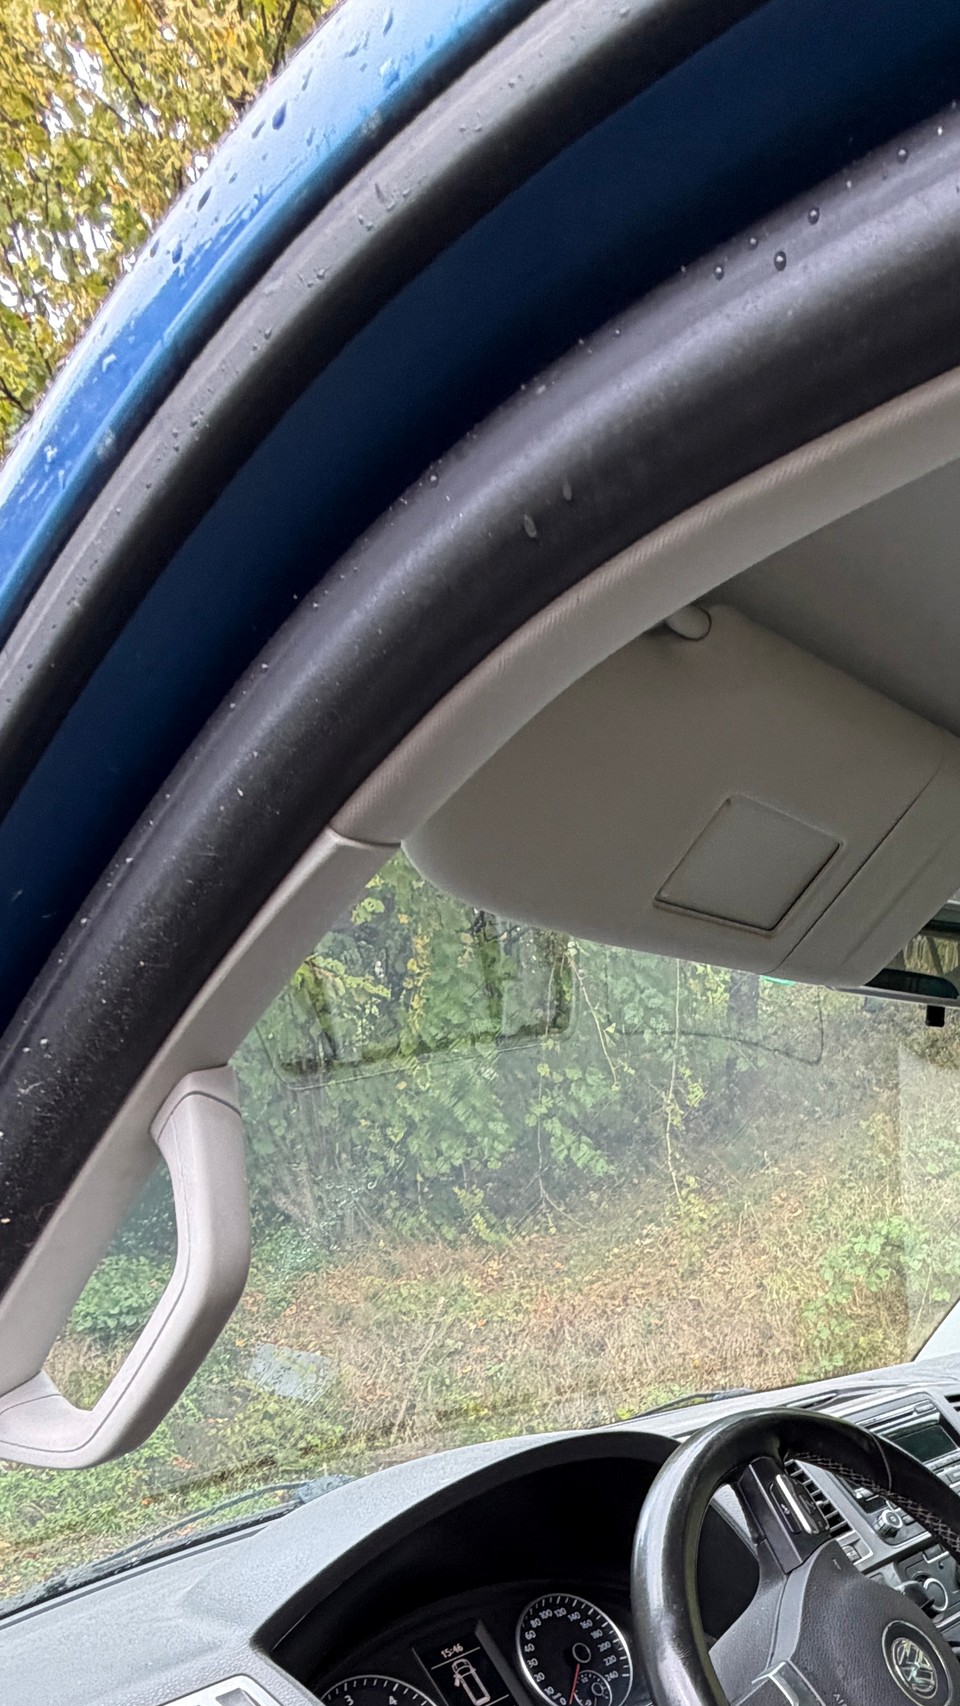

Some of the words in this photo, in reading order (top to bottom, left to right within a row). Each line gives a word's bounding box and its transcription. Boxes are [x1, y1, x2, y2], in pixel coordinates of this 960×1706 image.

[539, 1609, 553, 1620] 100
[554, 1607, 567, 1617] 120
[567, 1611, 581, 1622] 140
[530, 1618, 541, 1628] 80
[580, 1619, 593, 1629] 160
[525, 1630, 536, 1640] 60
[590, 1629, 603, 1639] 180
[440, 1643, 464, 1658] 15:46
[524, 1643, 535, 1653] 40
[597, 1641, 611, 1652] 200
[527, 1658, 538, 1668] 30
[603, 1655, 617, 1666] 220
[534, 1672, 545, 1682] 20
[604, 1670, 619, 1681] 240
[544, 1686, 555, 1696] 10
[344, 1695, 354, 1706] 3
[388, 1695, 398, 1706] 4
[559, 1697, 567, 1706] 0
